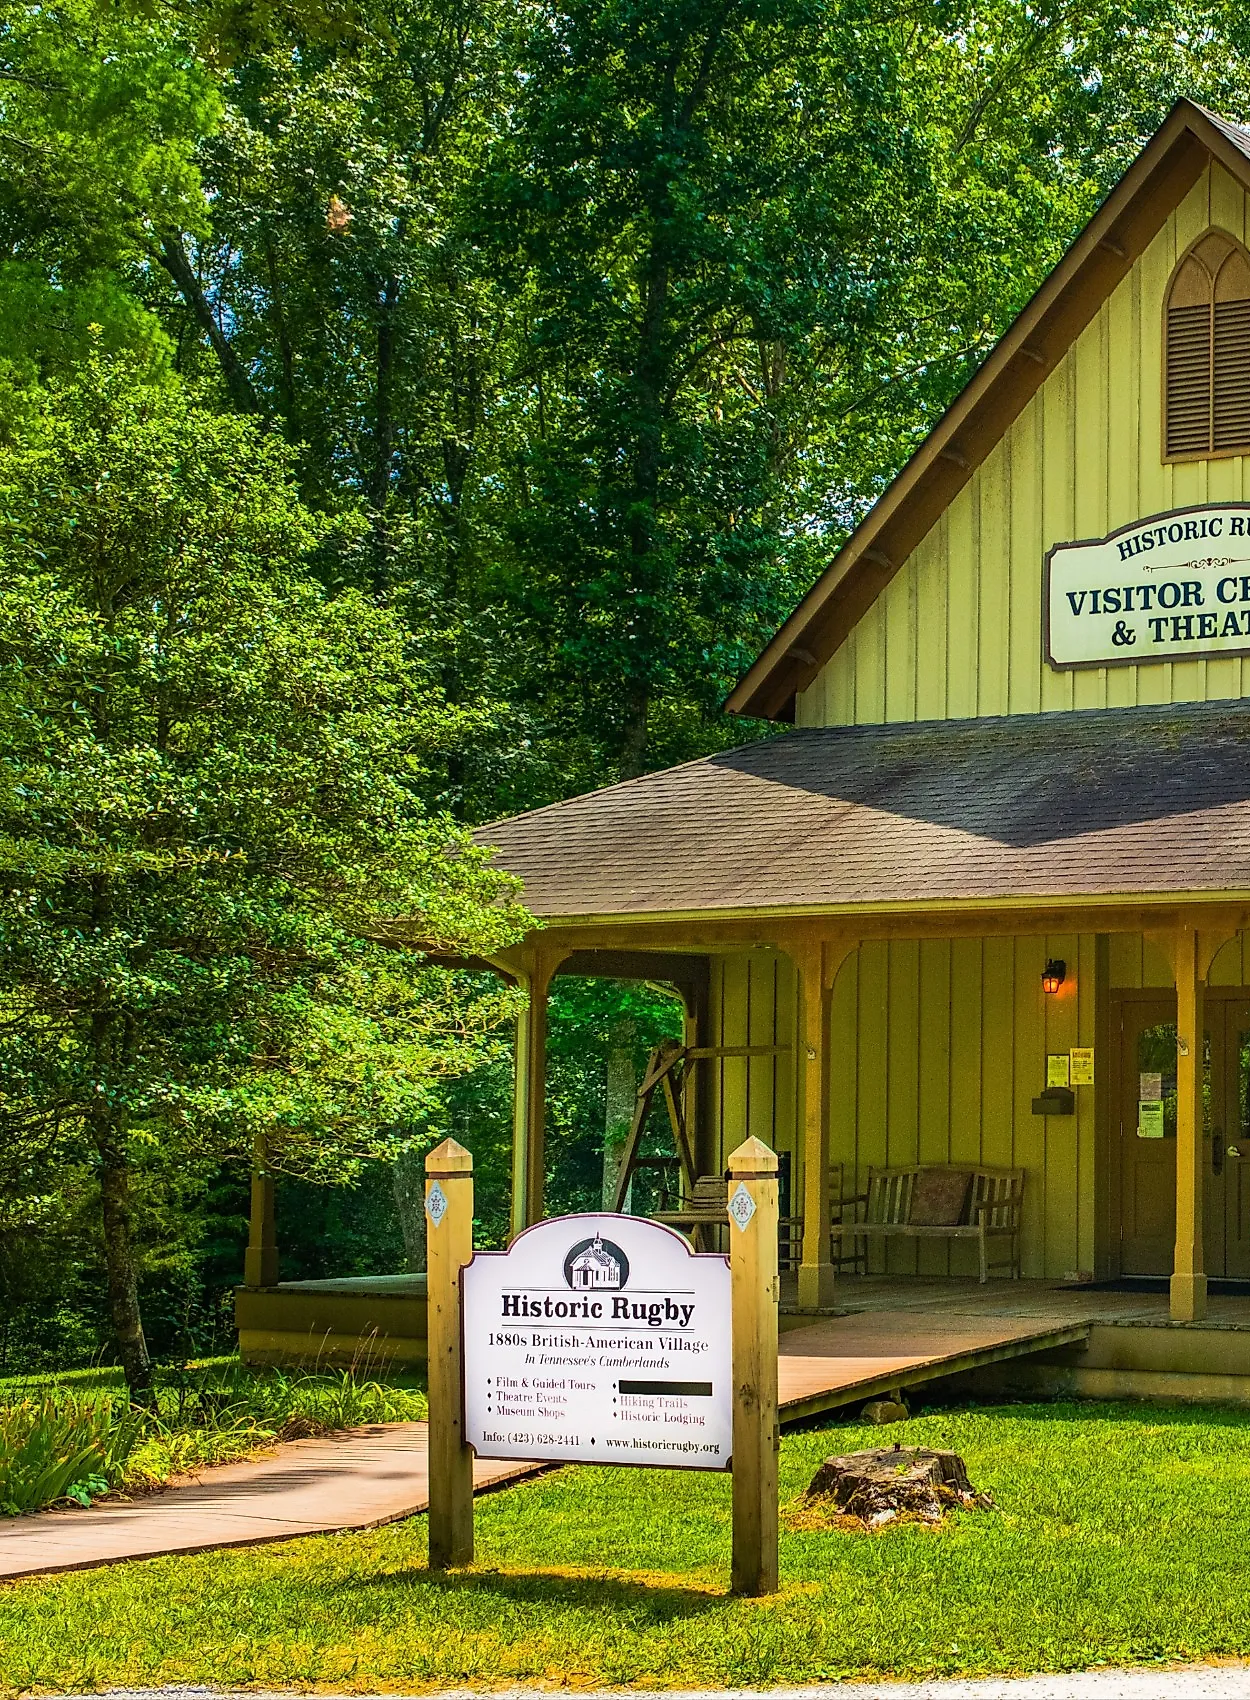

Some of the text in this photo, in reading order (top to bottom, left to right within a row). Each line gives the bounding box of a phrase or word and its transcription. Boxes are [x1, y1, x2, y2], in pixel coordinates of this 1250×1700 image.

[1116, 517, 1223, 561] HISTORIC
[1066, 580, 1205, 616] VISITOR
[1111, 620, 1137, 647] &
[501, 1294, 695, 1327] Historic Rugby
[488, 1332, 709, 1354] 1880s British-American Village
[524, 1353, 670, 1369] In Tennessee's Cumberlands
[496, 1376, 596, 1391] Film & Guided Tours
[496, 1390, 568, 1404] Theatre Events
[620, 1395, 688, 1409] Hiking Trails
[496, 1405, 566, 1420] Museum Shops
[620, 1410, 705, 1426] Historic Lodging
[482, 1430, 720, 1455] Info: (423) 628-2441 www.historicrugby.org
